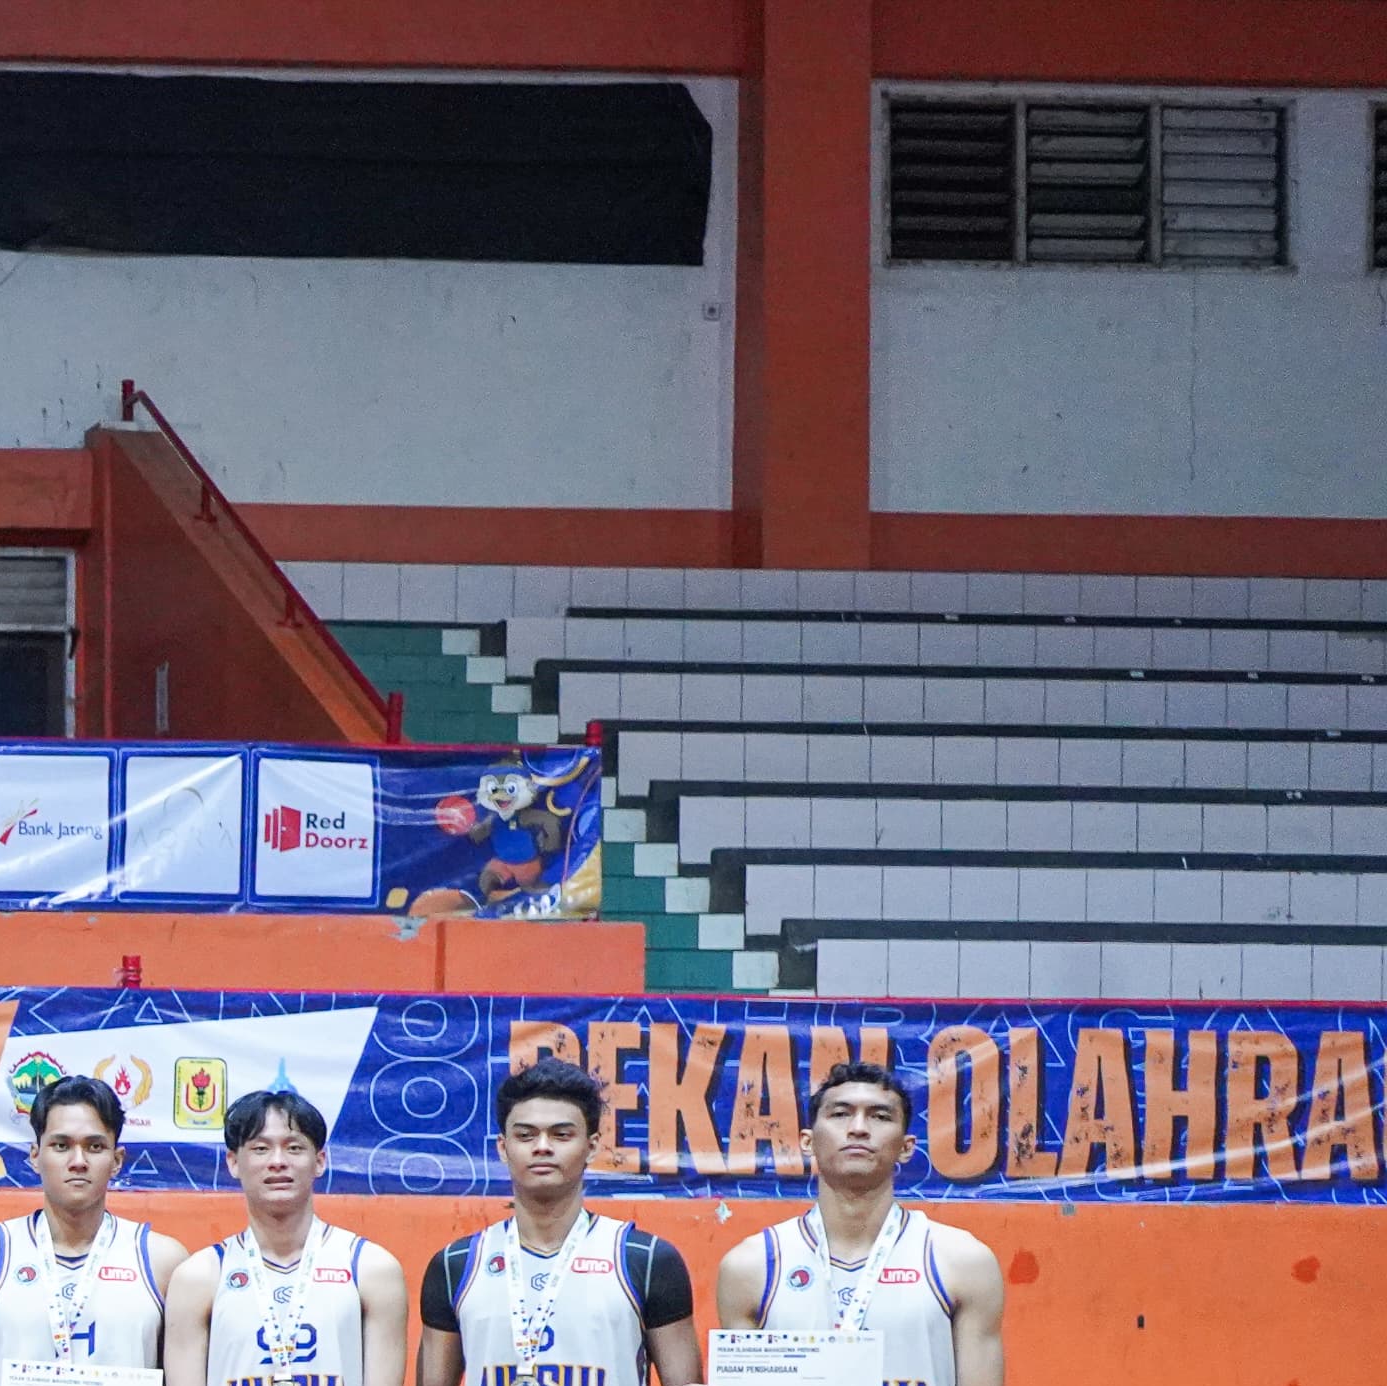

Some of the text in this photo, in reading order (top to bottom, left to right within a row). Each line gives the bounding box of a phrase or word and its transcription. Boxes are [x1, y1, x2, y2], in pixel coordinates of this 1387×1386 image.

[306, 812, 346, 831] Red
[18, 820, 104, 841] Bank Jateng
[305, 832, 369, 850] Doorz
[927, 1027, 1387, 1182] OLAHRA
[122, 1118, 152, 1127] ENGAH
[573, 1259, 610, 1273] LIMA
[100, 1268, 135, 1281] LIMA
[881, 1270, 917, 1282] LIMA
